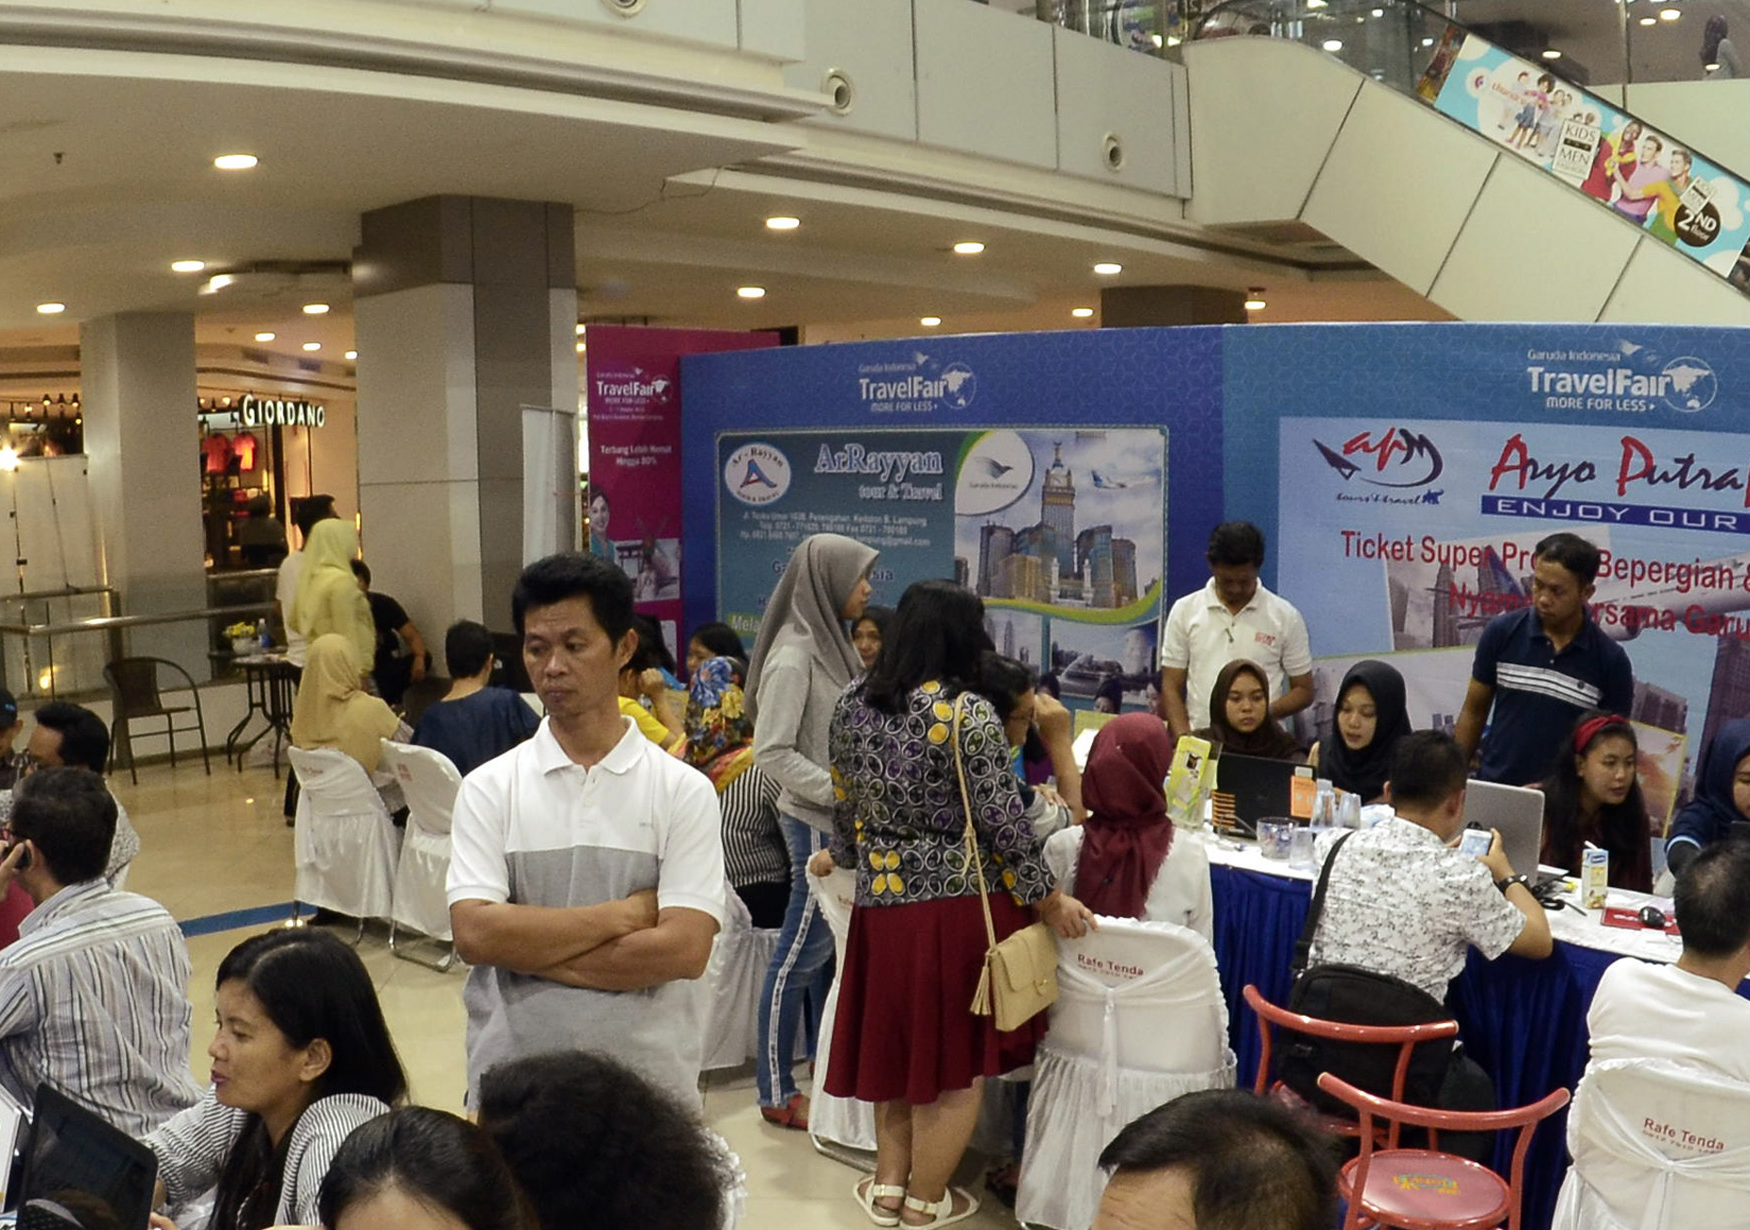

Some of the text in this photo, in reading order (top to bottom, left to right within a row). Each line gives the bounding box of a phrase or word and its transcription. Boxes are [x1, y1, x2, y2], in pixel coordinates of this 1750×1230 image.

[1565, 123, 1597, 143] KIDS
[1558, 147, 1591, 166] MEN
[1527, 349, 1622, 362] Garuda Indonesia
[596, 380, 656, 397] TravelFair
[858, 375, 949, 400] TravelFair
[1526, 366, 1671, 397] TravelFair
[242, 394, 326, 428] GIORDANO
[896, 401, 912, 411] FOR
[1546, 396, 1647, 412] MORE FOR LESS
[814, 443, 944, 482] ArRayyan
[1488, 433, 1744, 500] Aryo Putra
[858, 484, 885, 500] tour
[1497, 498, 1739, 530] ENJOY OUR
[1340, 530, 1415, 562] Ticket
[1421, 536, 1494, 569] Super
[1597, 549, 1735, 594] Bepergian
[731, 615, 759, 633] Mela
[1592, 600, 1676, 632] rsama
[1077, 953, 1104, 969] Rafe
[1107, 960, 1145, 976] Tenda
[1643, 1117, 1726, 1151] Rafe Tenda
